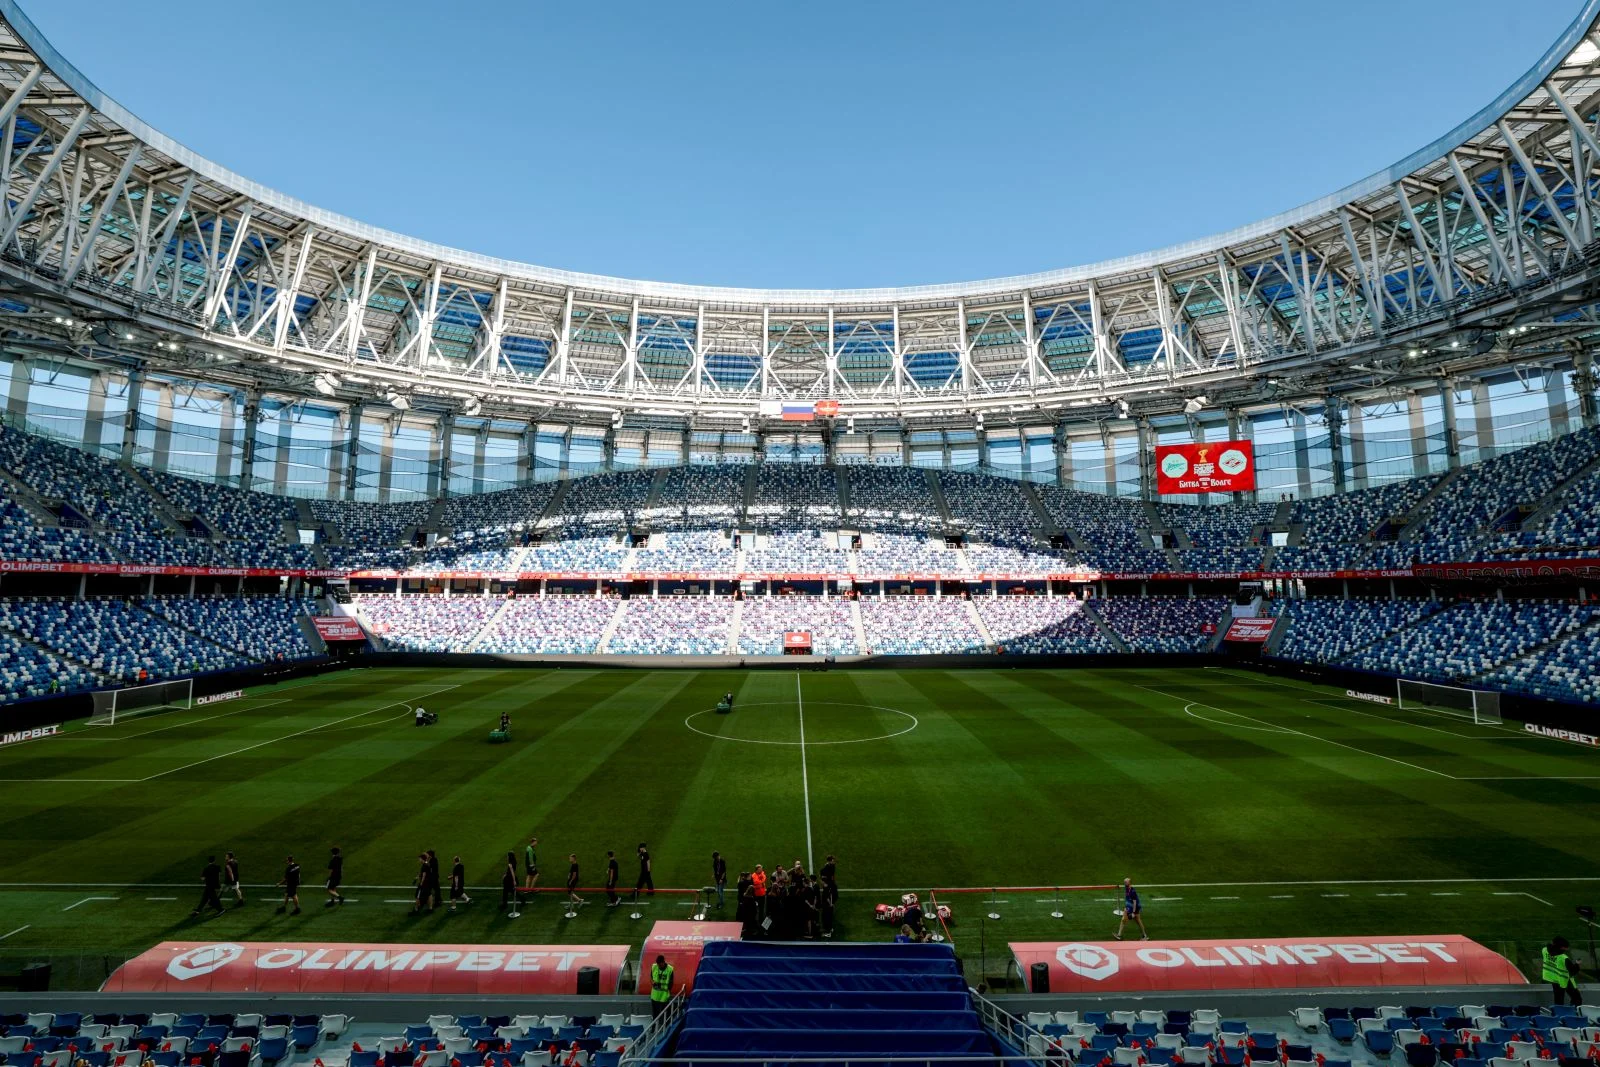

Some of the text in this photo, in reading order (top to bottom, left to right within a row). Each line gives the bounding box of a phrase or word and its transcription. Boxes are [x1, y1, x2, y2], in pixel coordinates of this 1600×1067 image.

[1, 562, 64, 571] OLIMPBET
[120, 565, 166, 573] OLIMPBET
[197, 689, 242, 704] OLIMPBET
[1346, 689, 1391, 704] OLIMPBET
[1525, 723, 1598, 745] OLIMPBET
[254, 949, 590, 971] OLIMPBET
[1136, 942, 1457, 968] OLIMPBET
